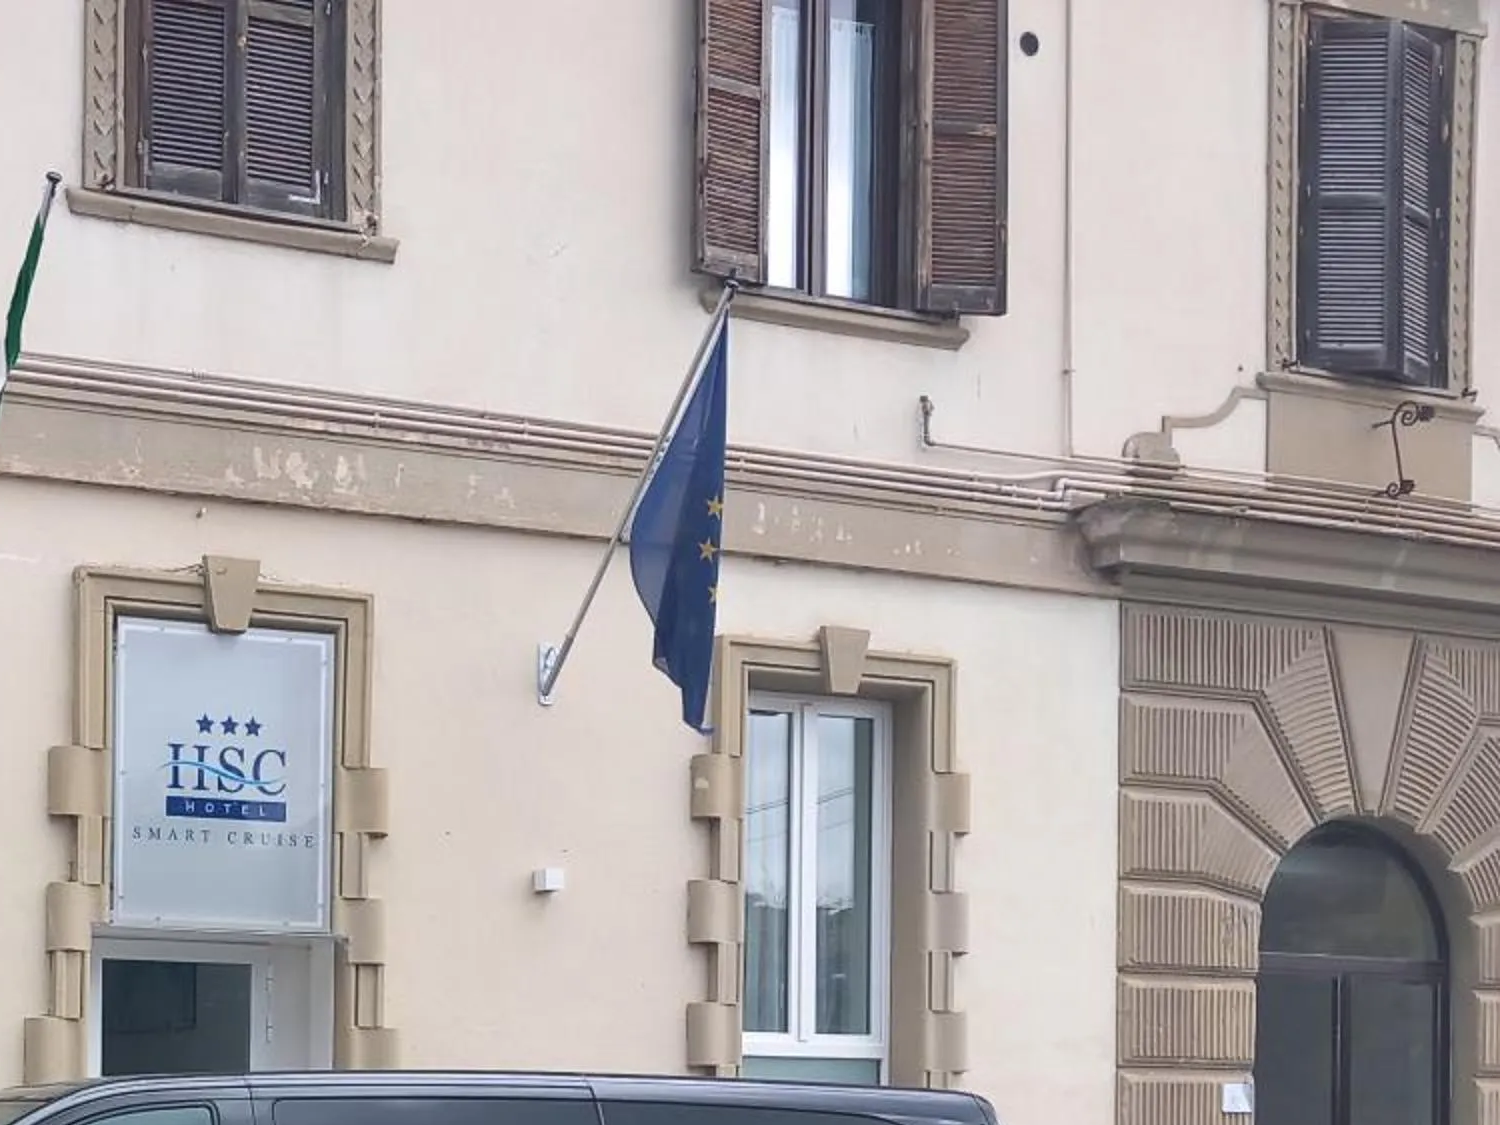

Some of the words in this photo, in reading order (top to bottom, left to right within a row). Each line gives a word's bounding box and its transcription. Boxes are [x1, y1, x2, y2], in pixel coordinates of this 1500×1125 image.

[166, 743, 287, 796] HSC
[184, 801, 266, 817] HOTEL
[132, 826, 211, 843] SMART
[227, 832, 315, 849] CRUISE
